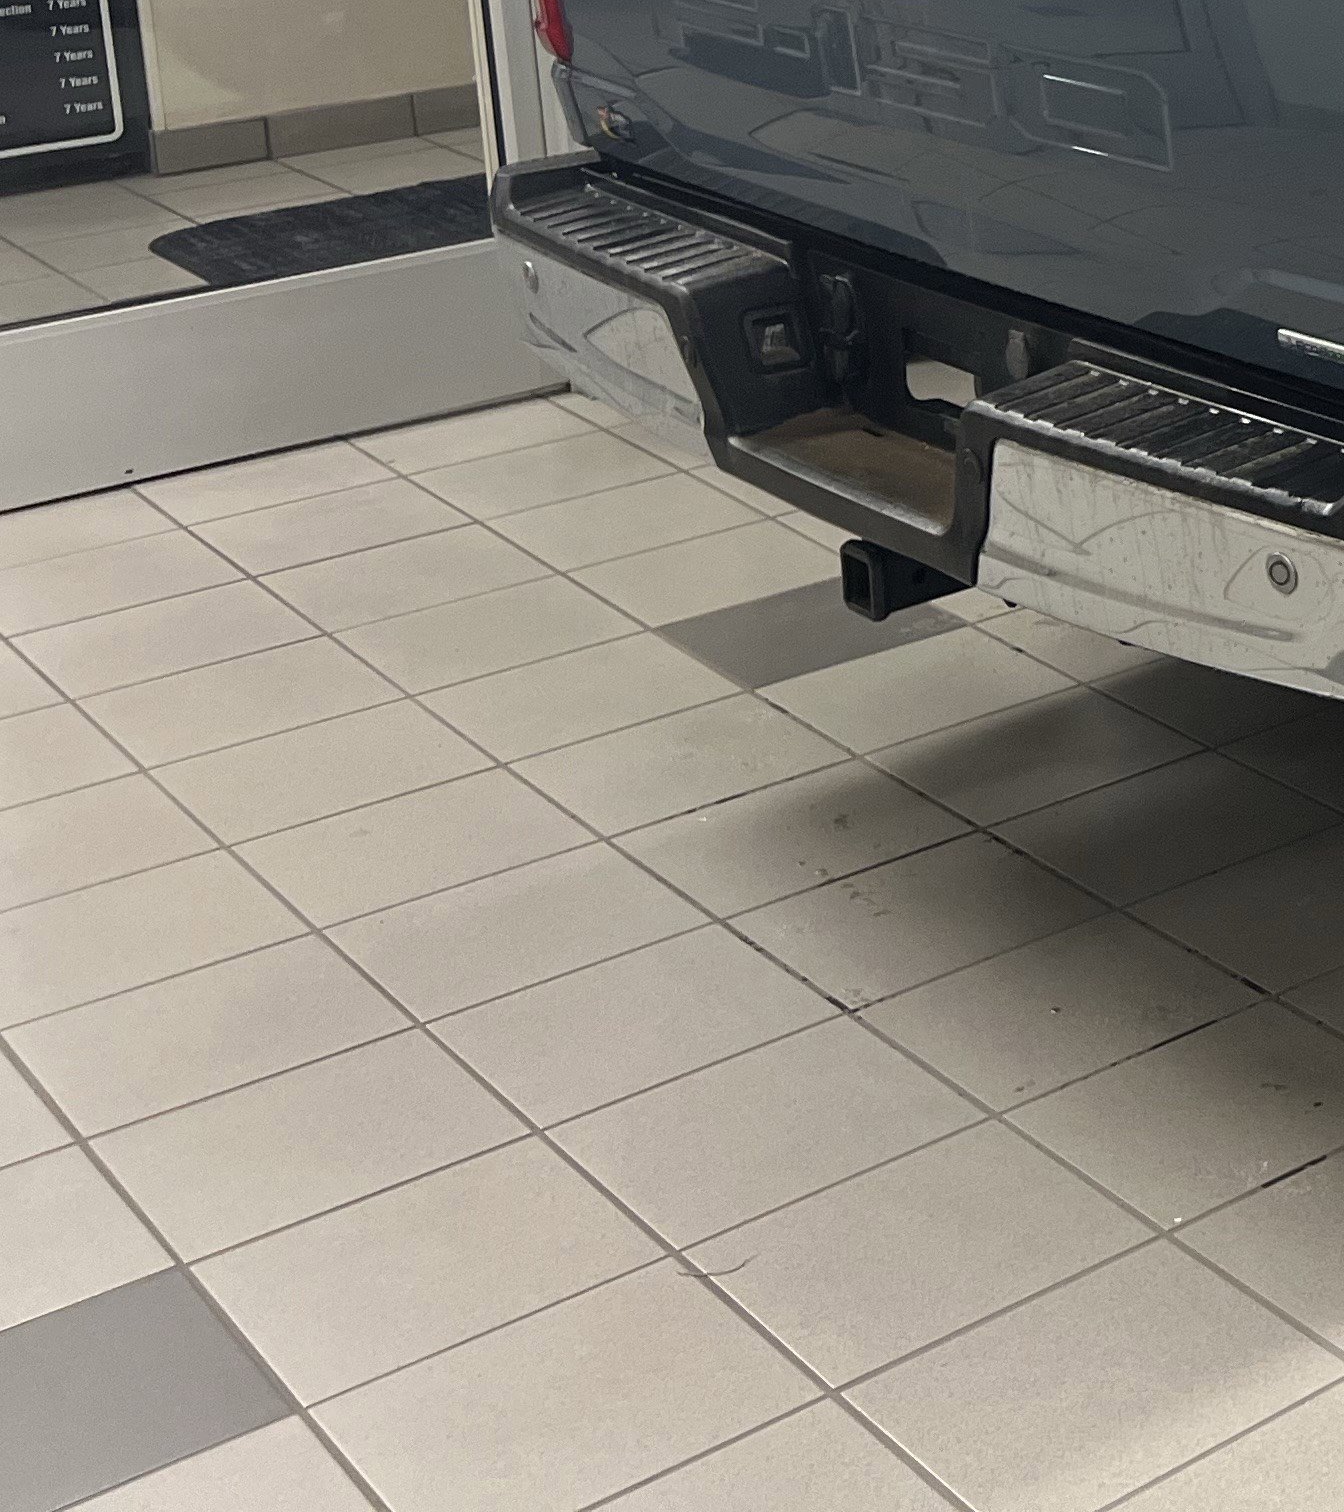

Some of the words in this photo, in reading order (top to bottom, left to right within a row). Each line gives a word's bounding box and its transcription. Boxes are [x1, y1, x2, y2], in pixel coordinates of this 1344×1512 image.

[47, 0, 54, 11] 7
[50, 25, 57, 37] 7
[60, 23, 90, 36] Years
[54, 51, 61, 63] 7
[64, 49, 93, 61] Years
[59, 77, 66, 89] 7
[69, 75, 99, 87] Years
[64, 103, 71, 115] 7
[74, 101, 103, 113] Years
